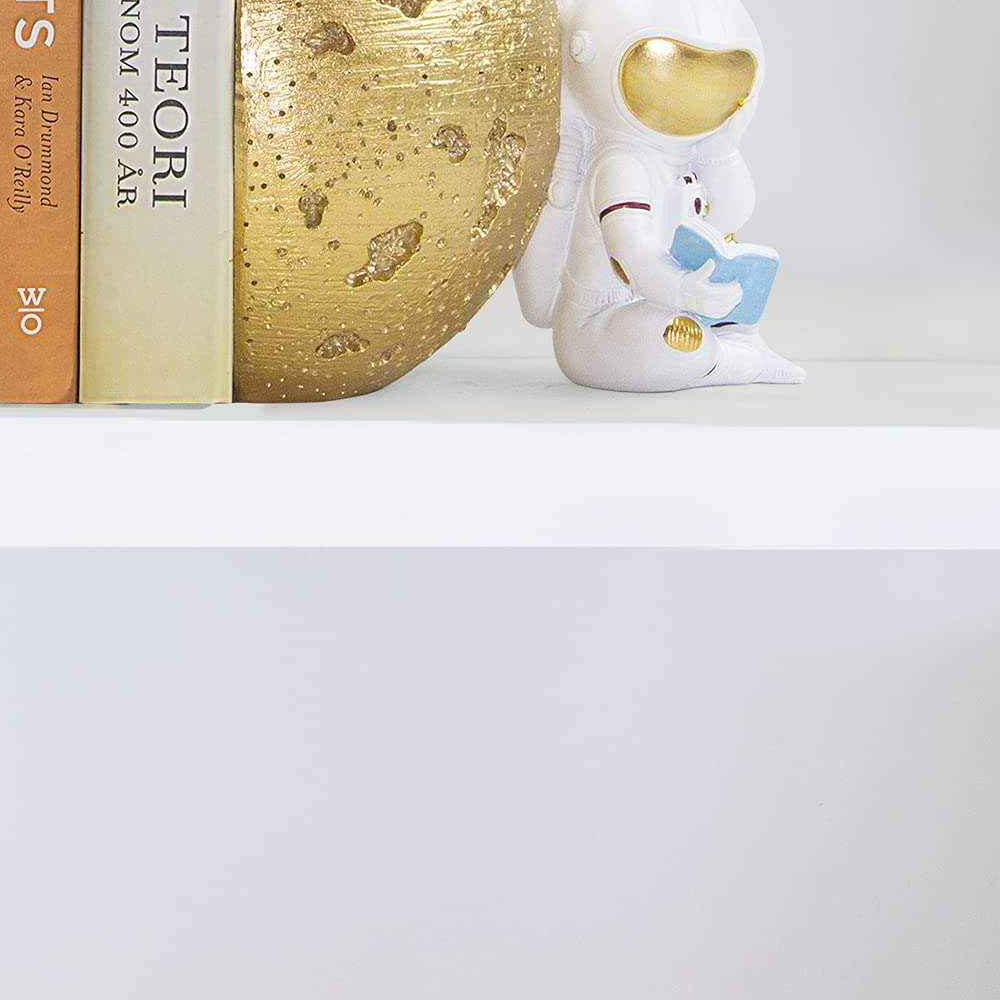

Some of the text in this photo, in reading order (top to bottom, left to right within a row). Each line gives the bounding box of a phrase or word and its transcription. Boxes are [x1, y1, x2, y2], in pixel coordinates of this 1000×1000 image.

[6, 74, 33, 213] & Kara O'Reilly
[40, 75, 59, 208] Ian Drummond
[116, 88, 141, 150] 400
[152, 15, 190, 209] TEORI
[116, 158, 143, 208] ÅR
